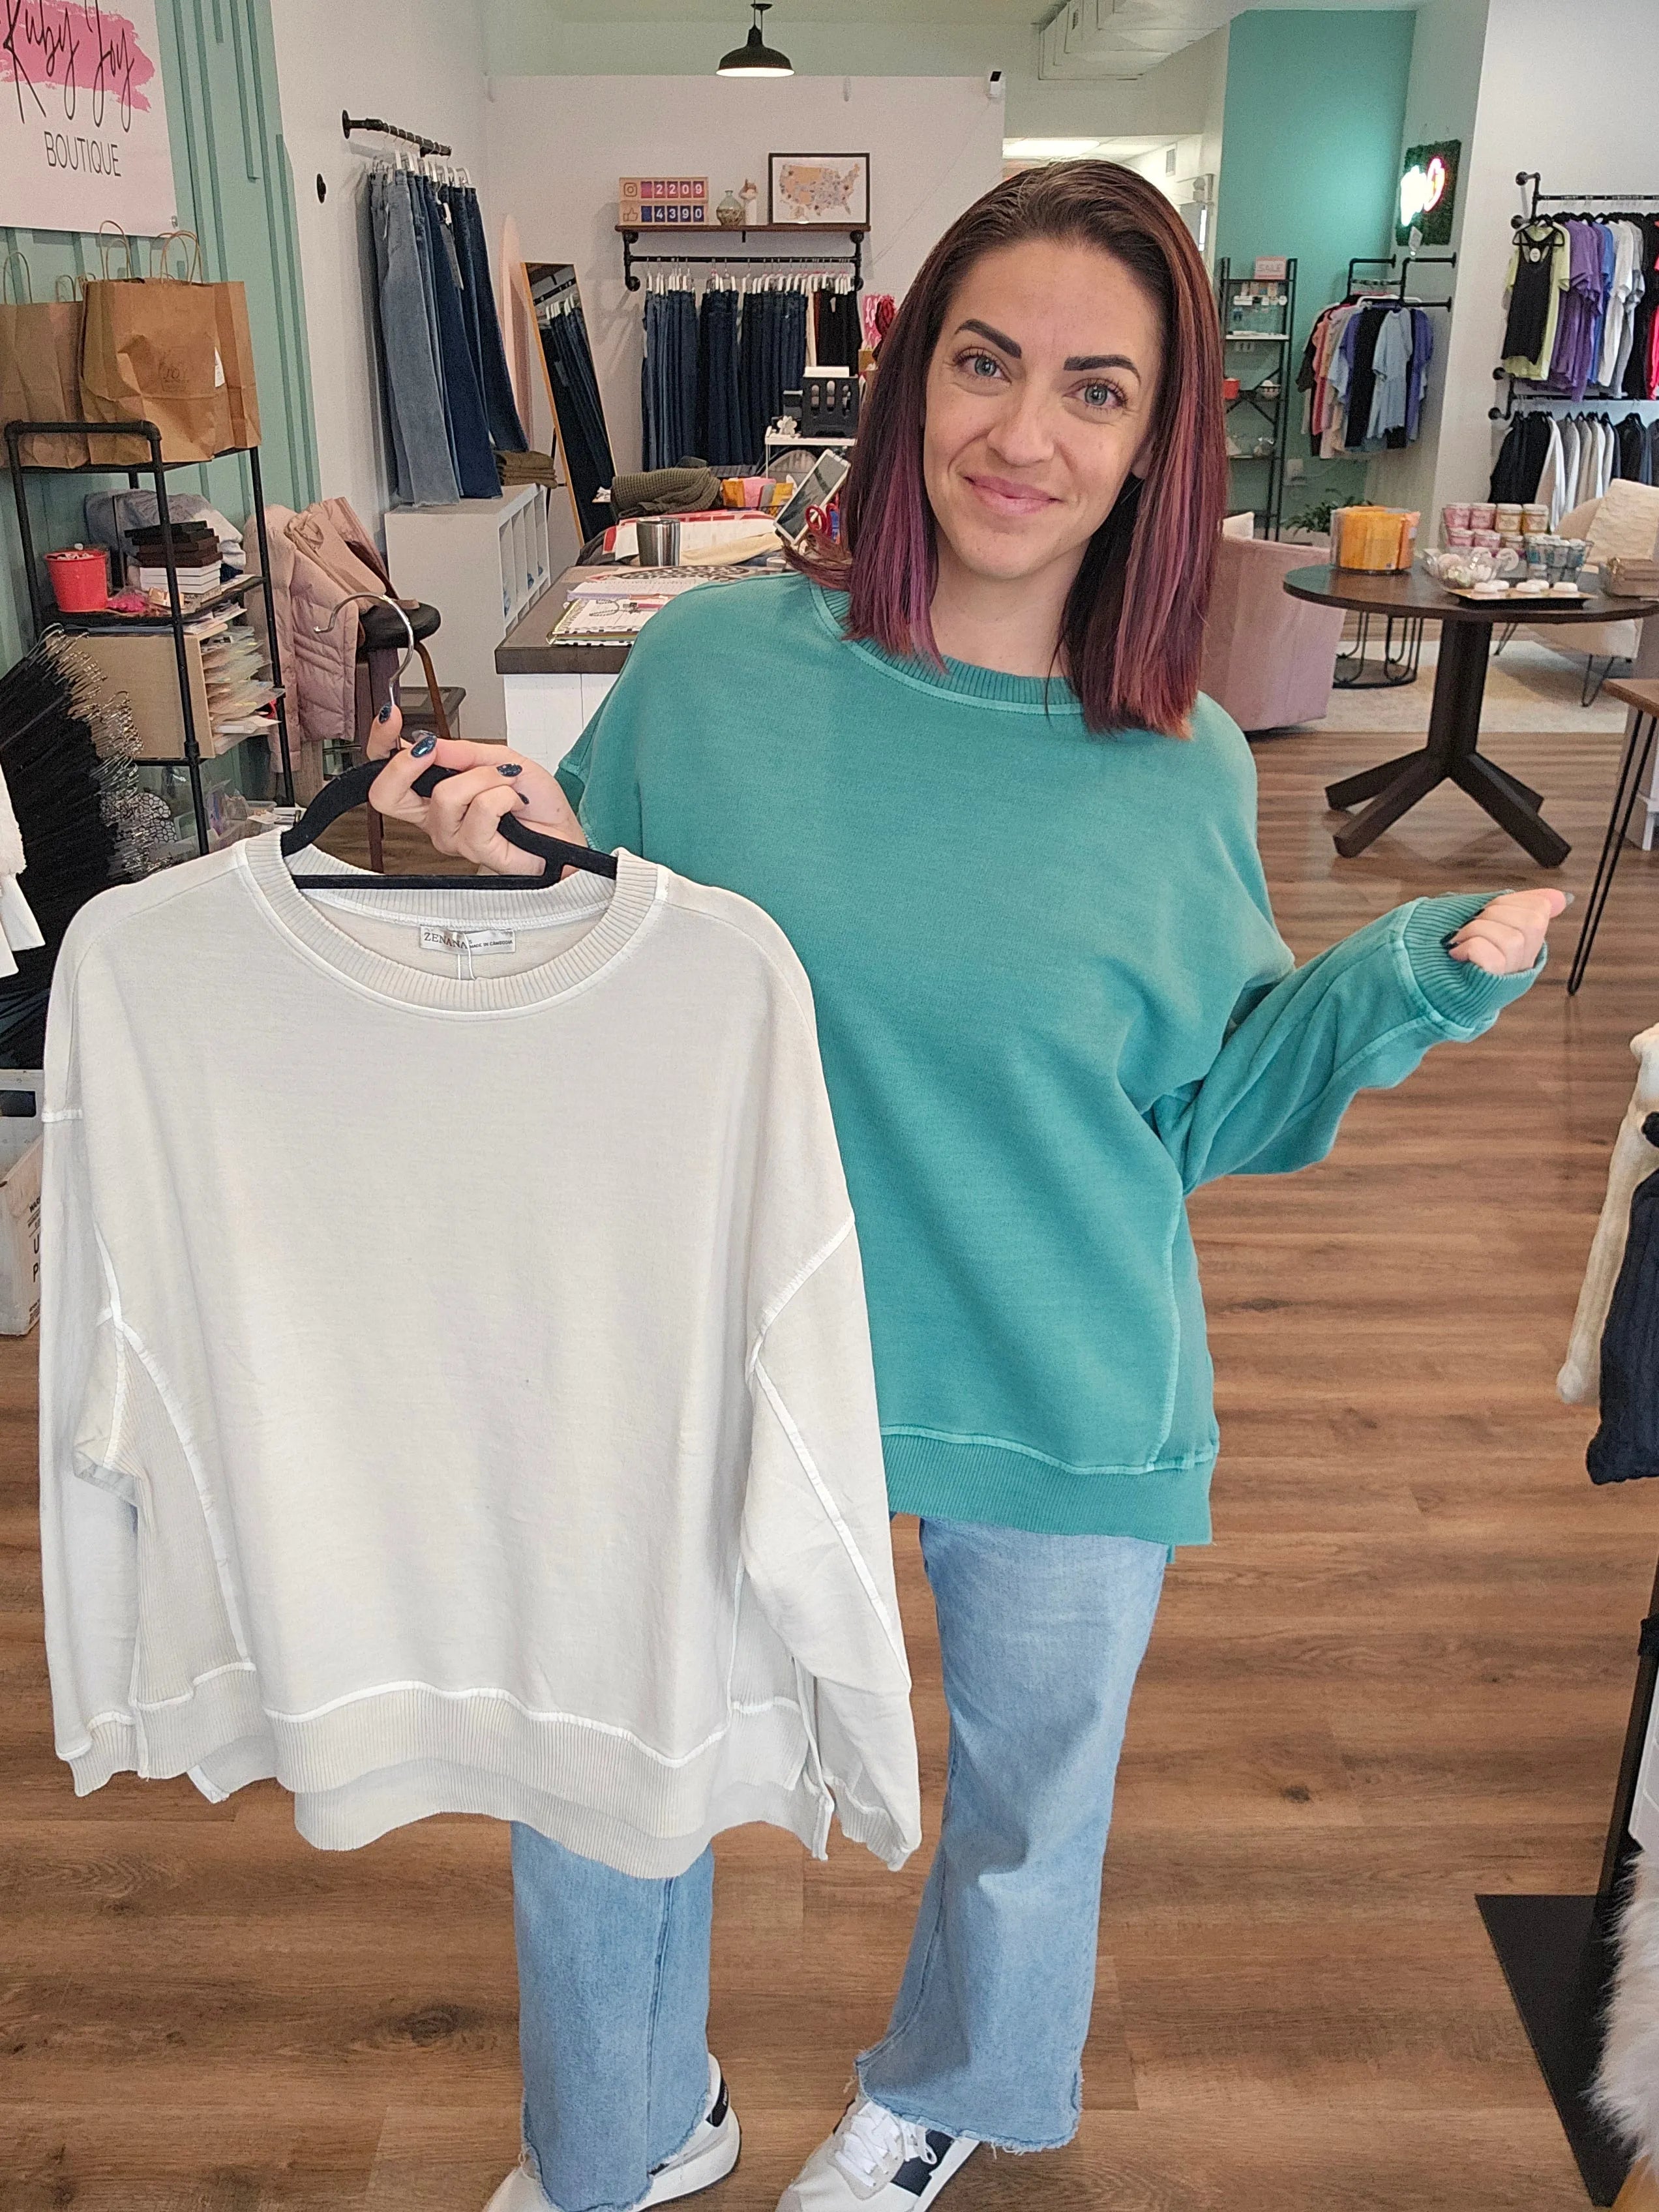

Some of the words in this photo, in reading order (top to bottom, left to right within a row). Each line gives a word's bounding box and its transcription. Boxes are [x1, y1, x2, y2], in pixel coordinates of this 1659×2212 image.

[3, 0, 80, 124] Ruby
[84, 0, 135, 132] Joy
[44, 131, 122, 177] BOUTIQUE
[656, 184, 702, 194] 2209
[656, 208, 702, 219] 4390
[424, 932, 468, 949] ZENANA
